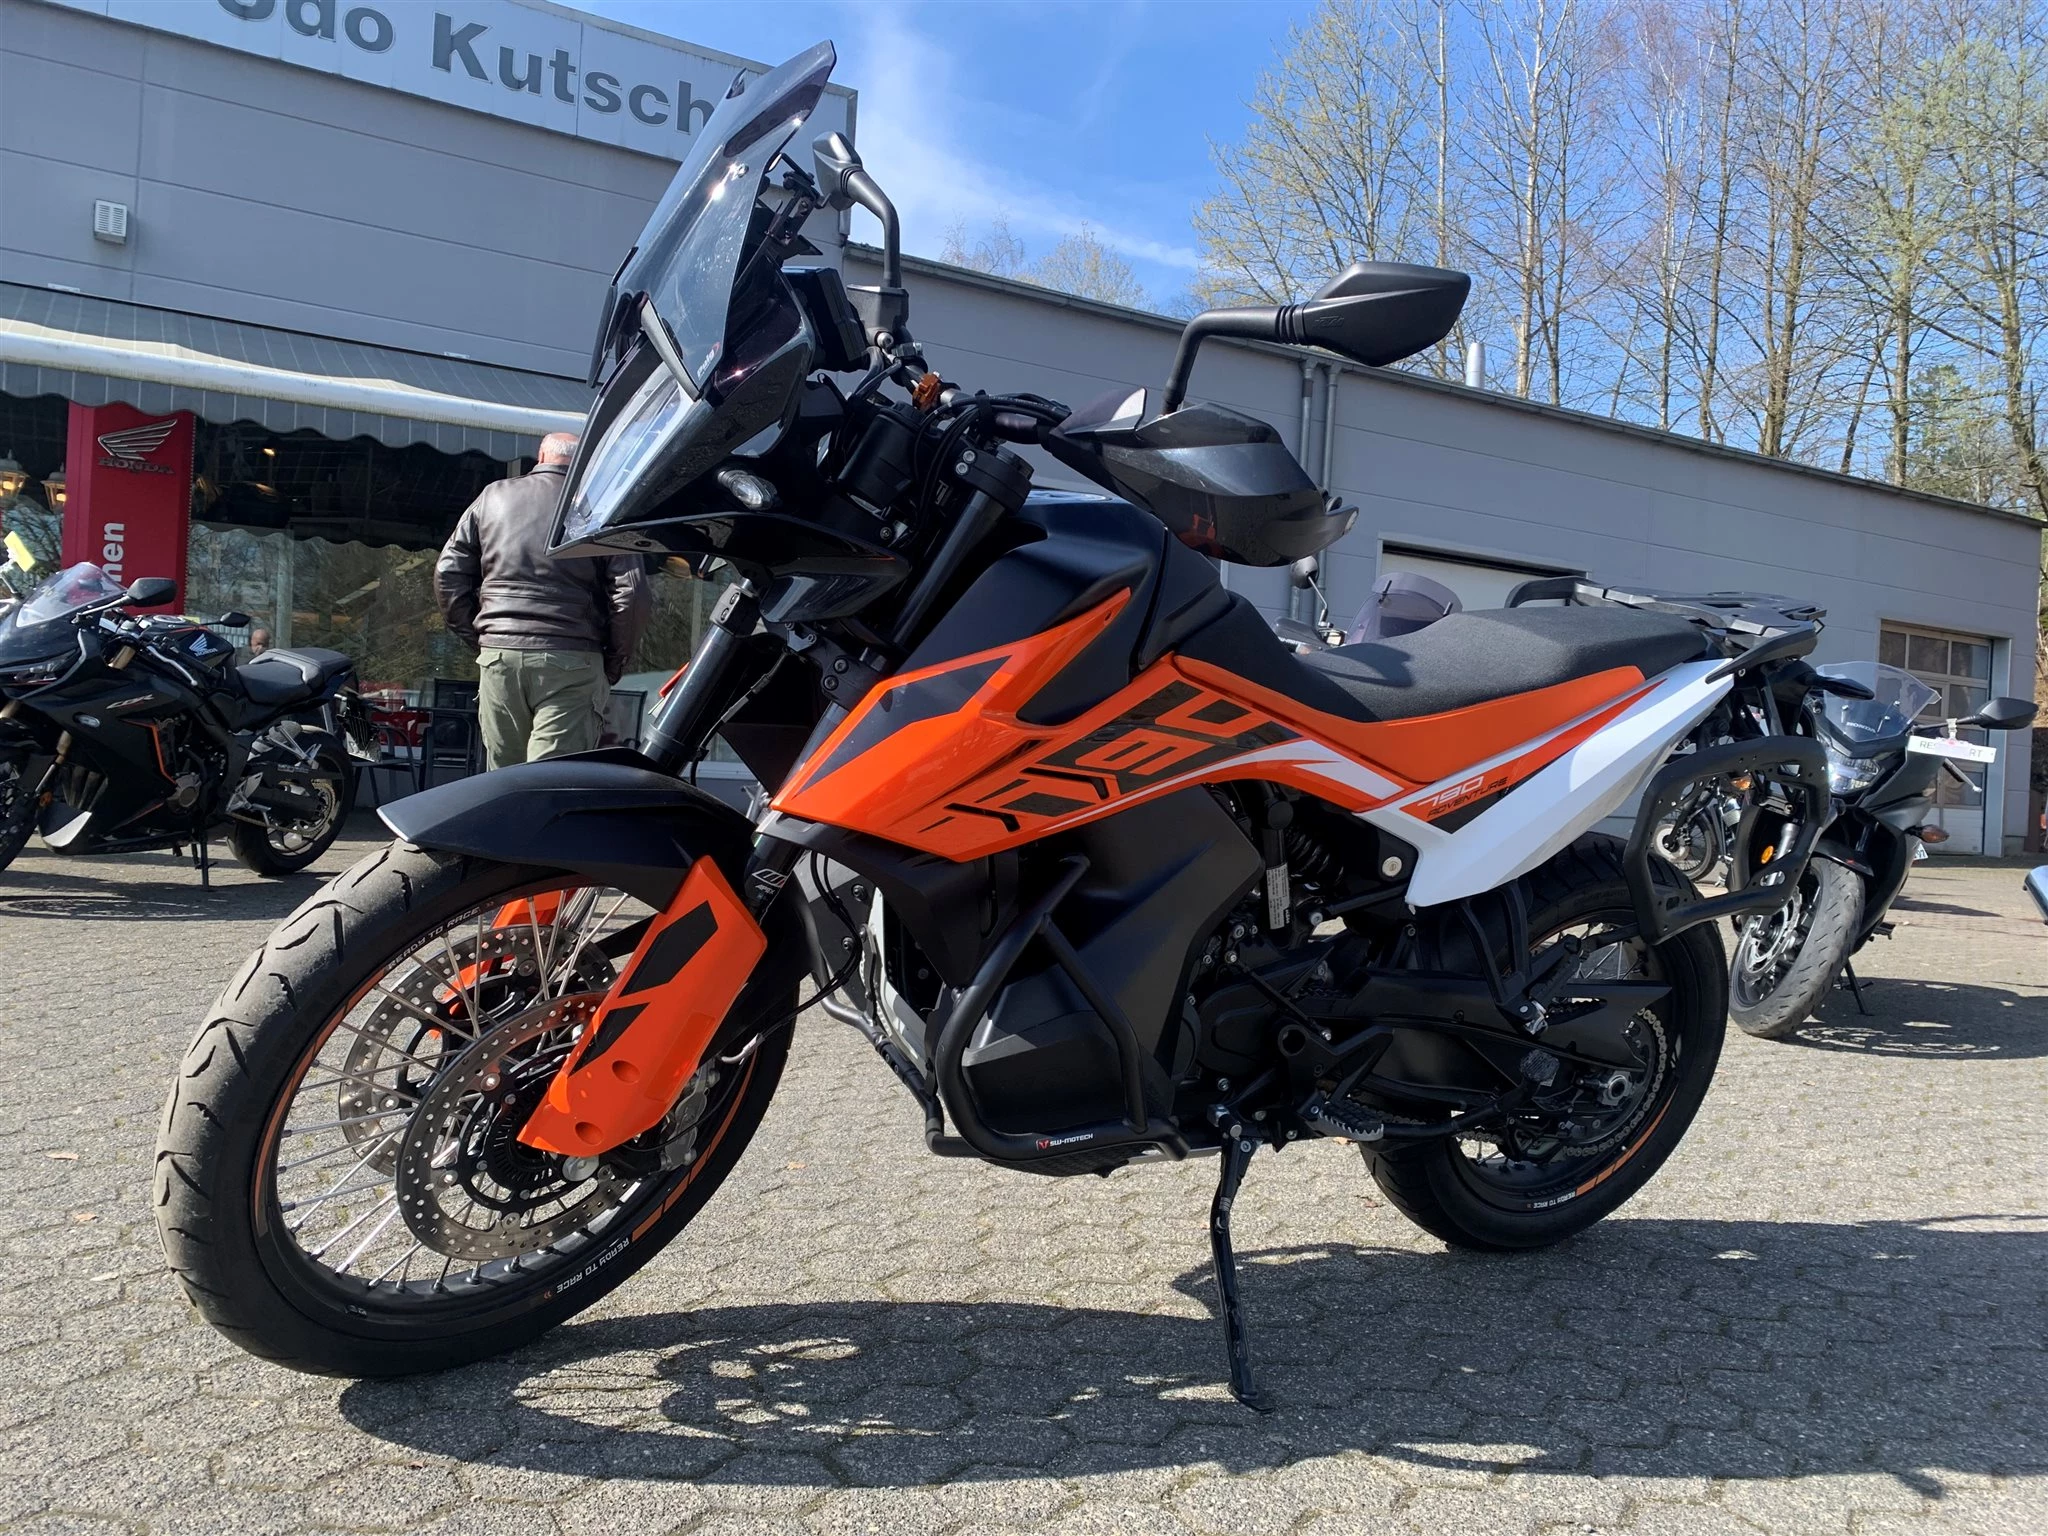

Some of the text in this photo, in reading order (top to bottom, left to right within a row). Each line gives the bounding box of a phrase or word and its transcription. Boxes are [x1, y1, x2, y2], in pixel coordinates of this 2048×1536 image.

[98, 457, 175, 475] HONDA
[1417, 775, 1485, 807] 790
[1427, 776, 1509, 818] ADVENTURE
[388, 906, 480, 970] READY TO RACE
[1050, 1133, 1094, 1147] SW-MOTECH
[557, 1237, 630, 1293] READY TO RACE
